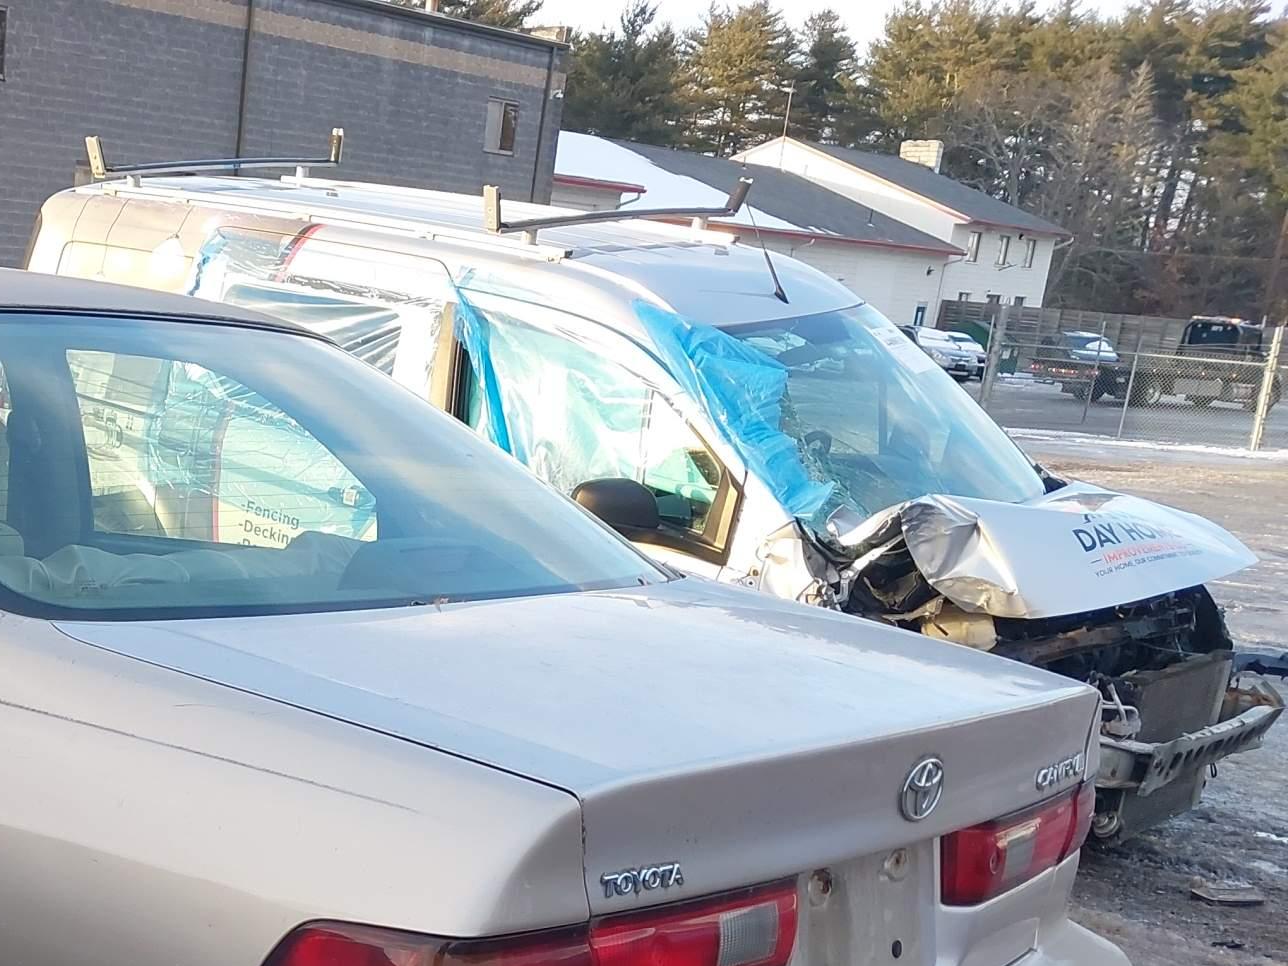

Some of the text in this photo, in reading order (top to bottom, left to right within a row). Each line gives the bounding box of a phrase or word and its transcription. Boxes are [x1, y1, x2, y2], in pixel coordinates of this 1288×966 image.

[241, 500, 300, 530] -Fencing
[238, 519, 290, 545] -Deckin
[1072, 523, 1121, 552] DAY
[600, 862, 684, 899] TOYOTA
